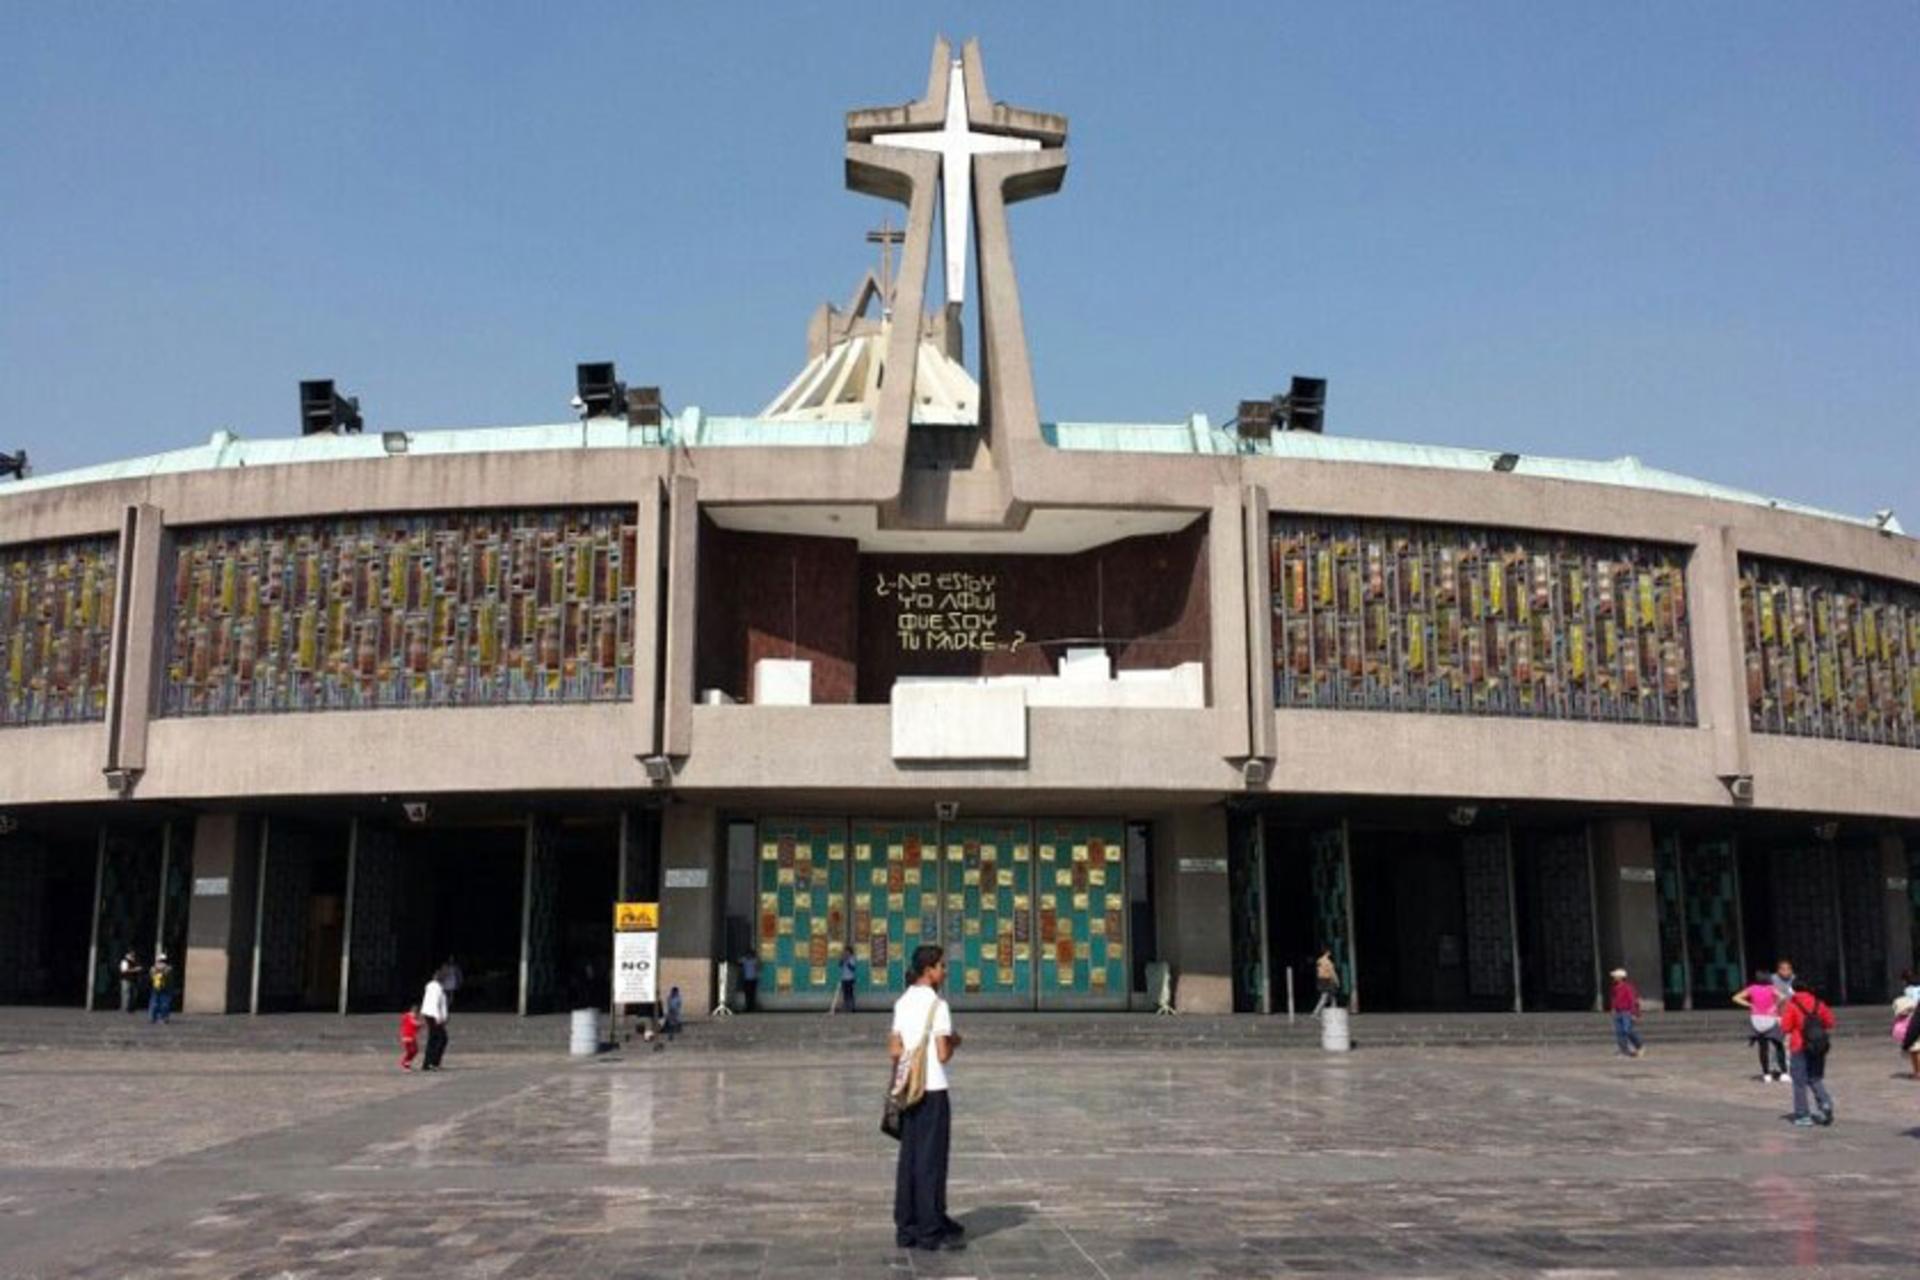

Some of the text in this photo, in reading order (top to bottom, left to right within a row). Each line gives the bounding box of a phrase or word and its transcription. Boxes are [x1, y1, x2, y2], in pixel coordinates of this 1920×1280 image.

[898, 592, 934, 610] YO
[898, 611, 998, 630] QUE SOY
[898, 630, 920, 650] TU
[621, 960, 651, 972] NO
